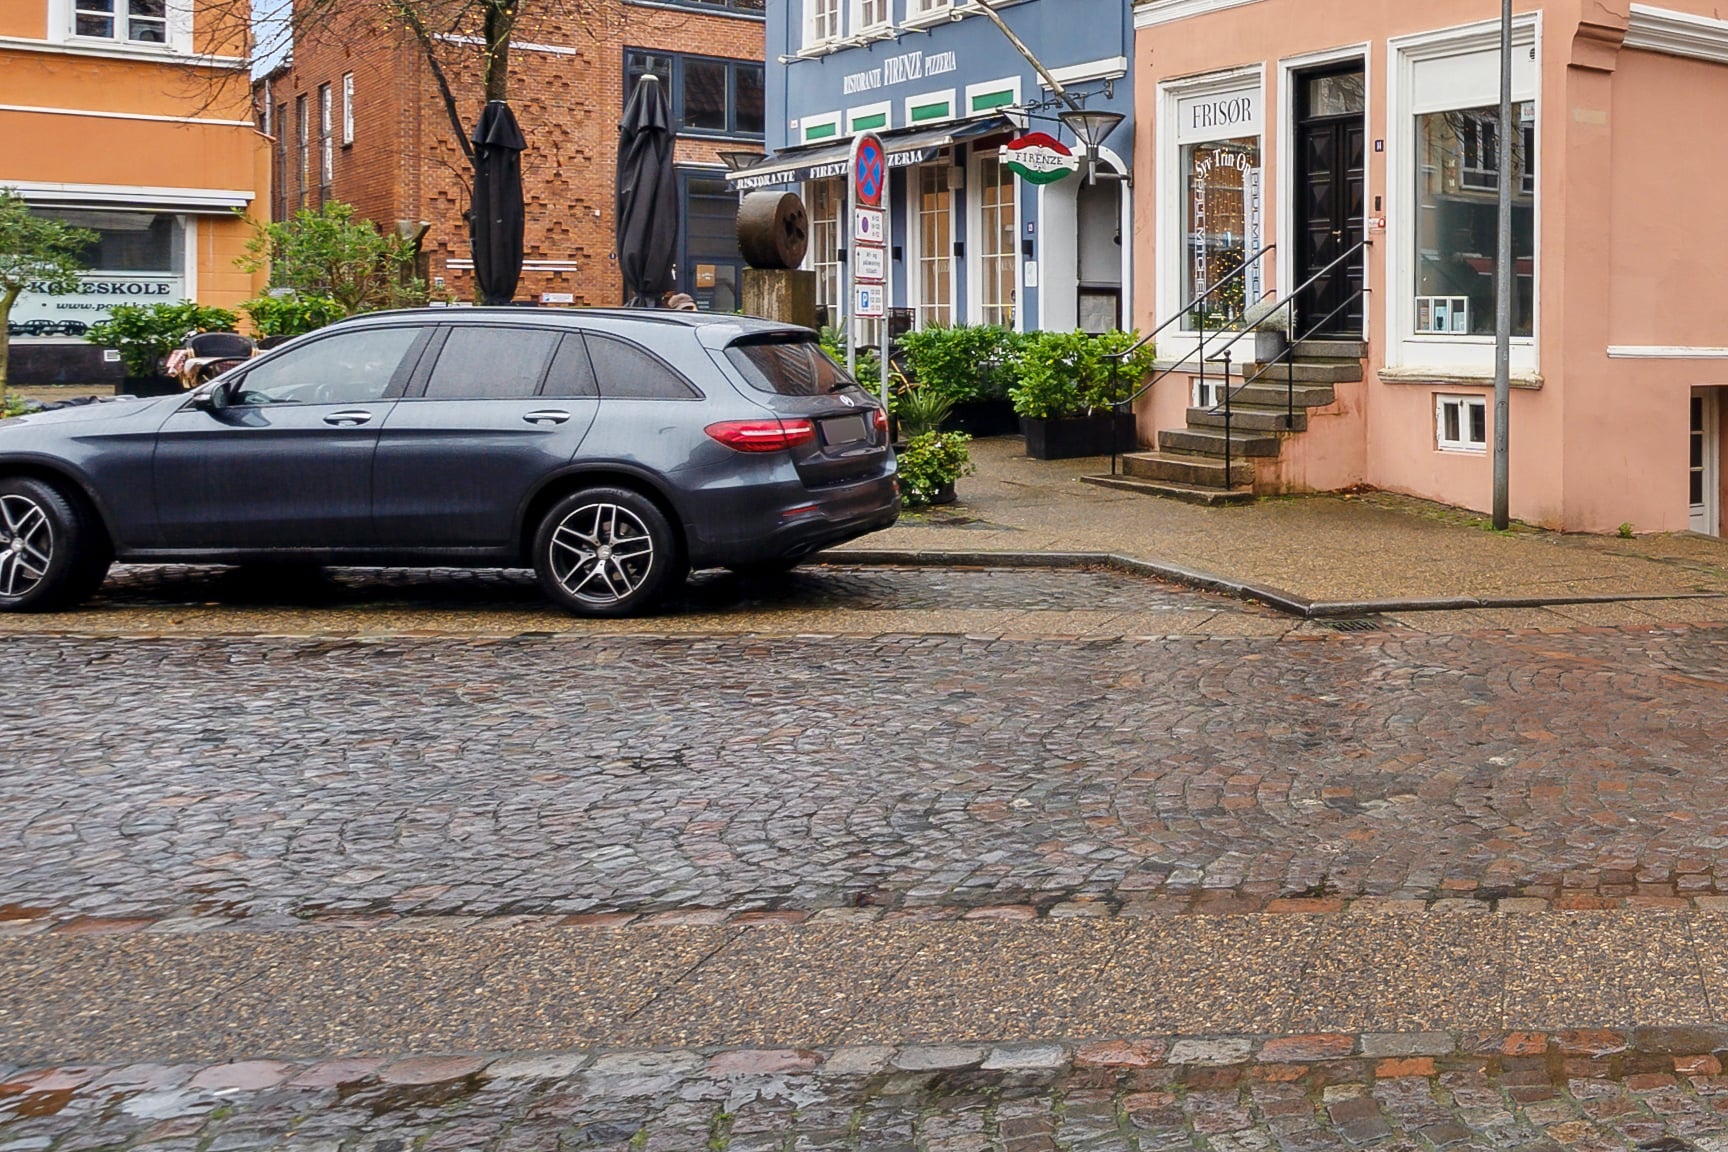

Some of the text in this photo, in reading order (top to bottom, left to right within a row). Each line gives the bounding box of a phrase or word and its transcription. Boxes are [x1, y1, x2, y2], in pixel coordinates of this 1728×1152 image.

[843, 50, 957, 95] RISTORANTE FIRENZE PIZZERIA
[1193, 96, 1251, 128] FRISØR
[736, 150, 923, 190] RISTORANTE FIRENZ ZERIA
[1015, 151, 1064, 165] FIRENZE
[1213, 147, 1234, 167] Trin
